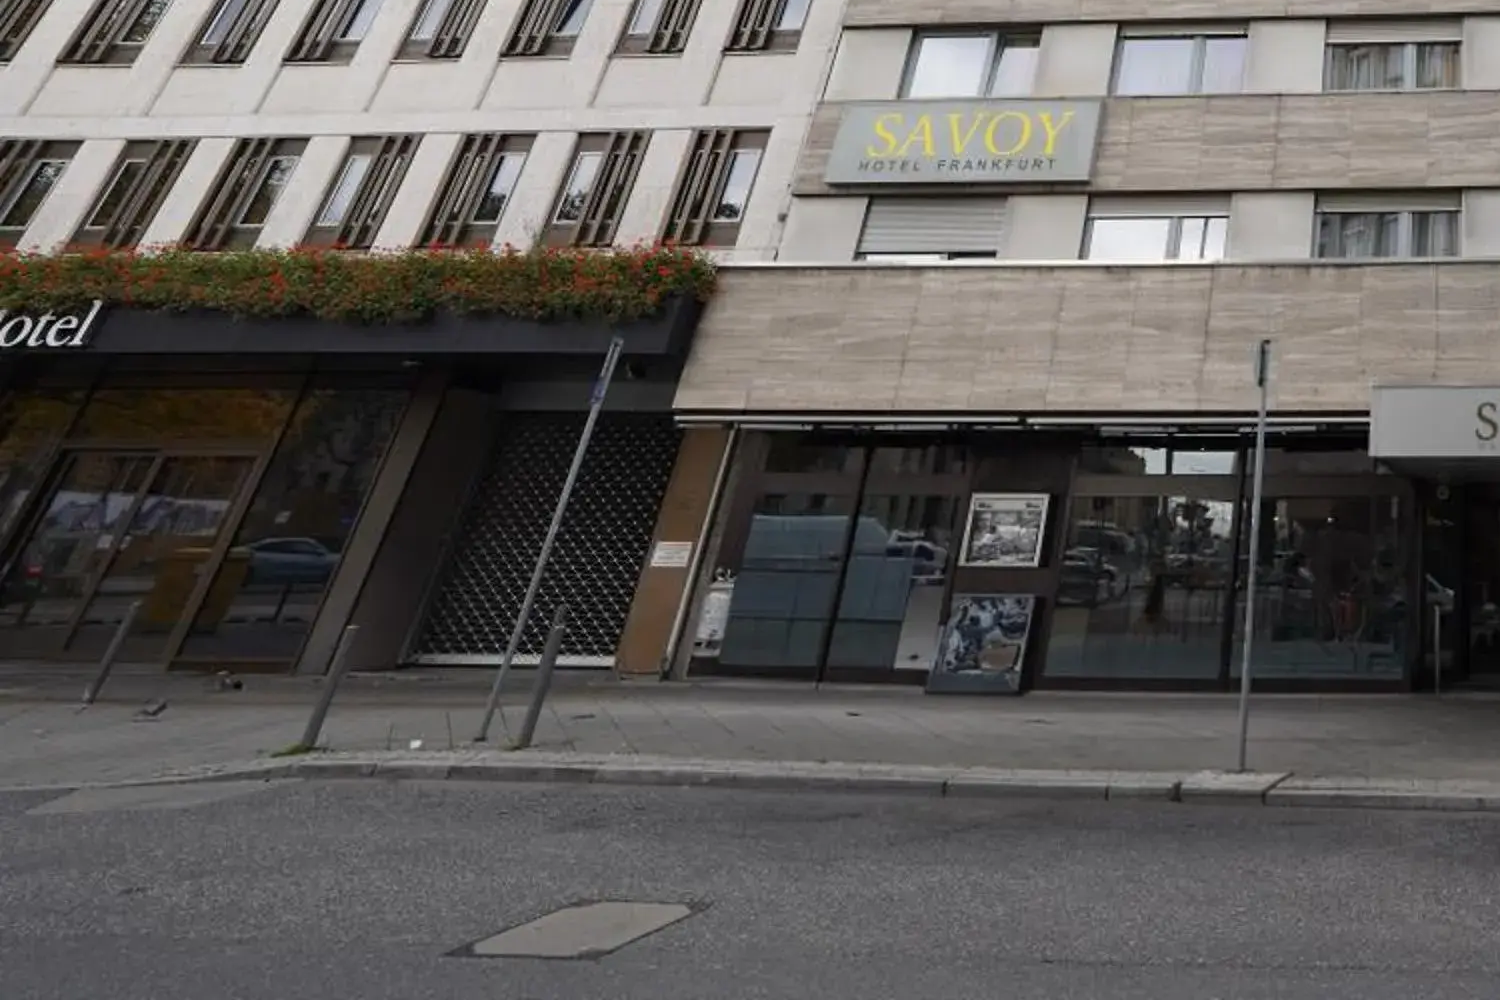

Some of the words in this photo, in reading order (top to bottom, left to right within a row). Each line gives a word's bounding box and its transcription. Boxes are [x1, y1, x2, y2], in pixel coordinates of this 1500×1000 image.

[866, 110, 1076, 158] SAVOY
[857, 159, 921, 173] HOTEL
[937, 157, 1059, 172] FRANKFURT
[0, 299, 103, 347] otel
